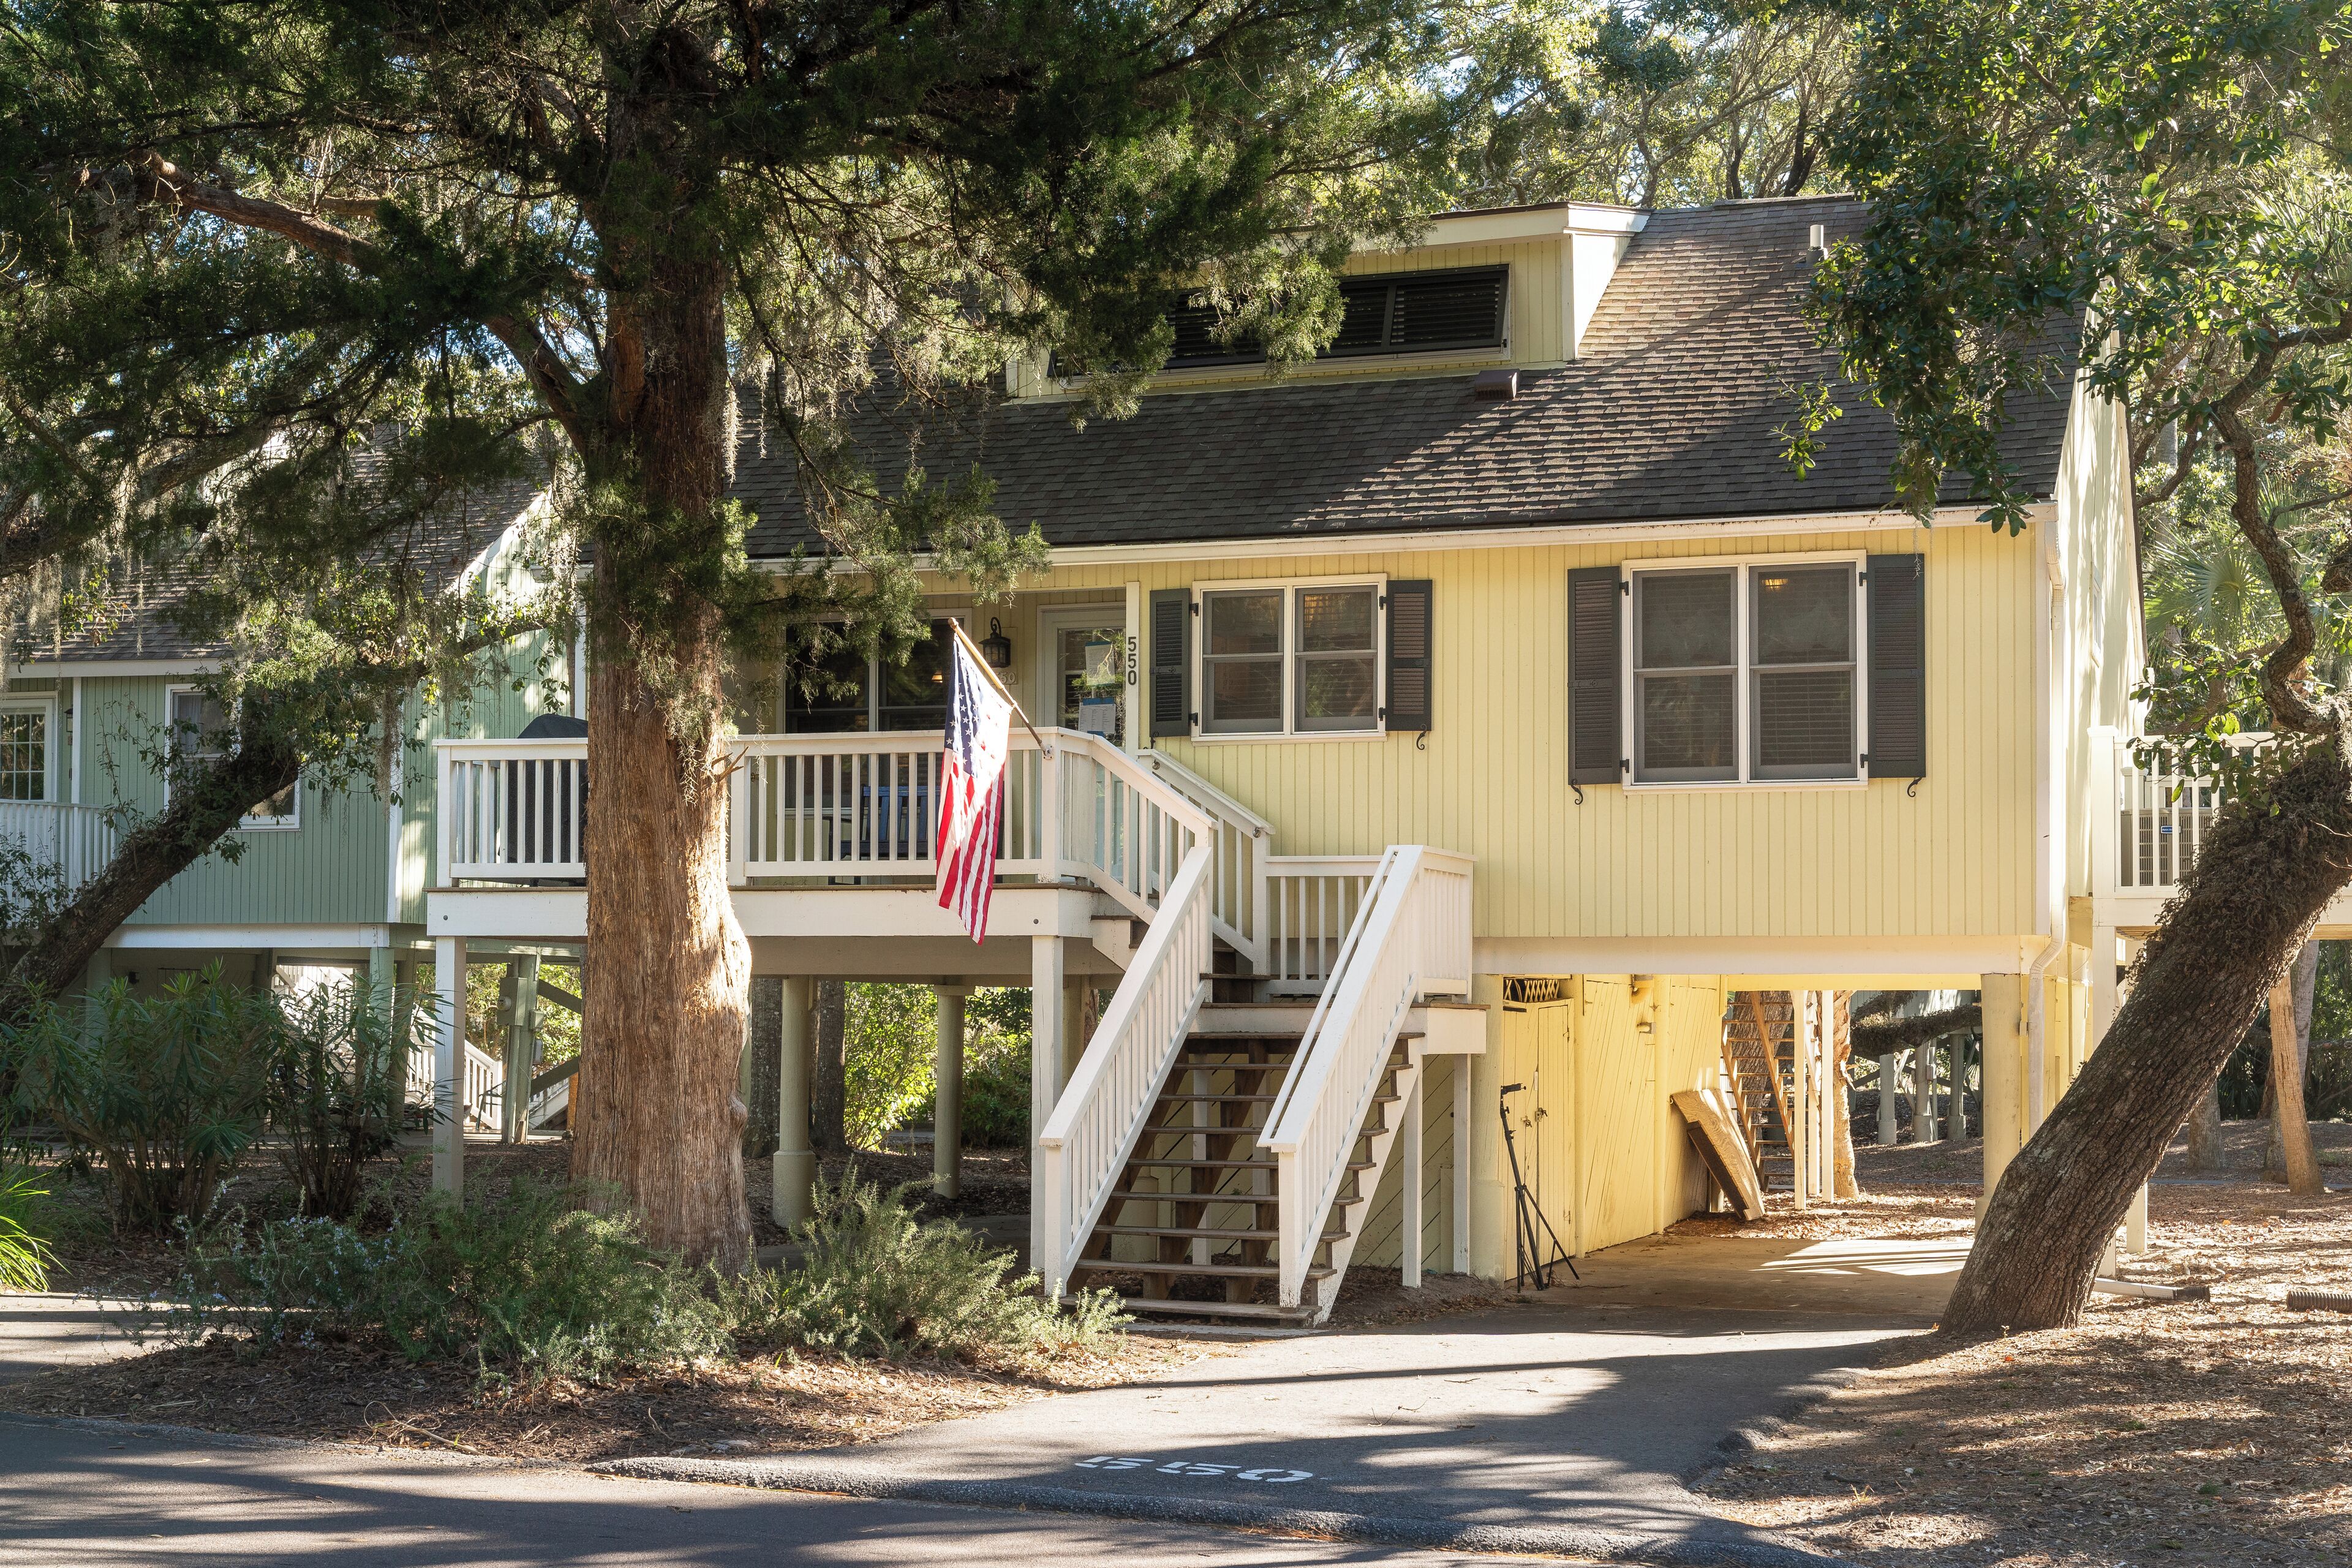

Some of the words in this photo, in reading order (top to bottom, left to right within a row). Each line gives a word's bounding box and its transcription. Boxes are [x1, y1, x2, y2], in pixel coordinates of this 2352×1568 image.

[1128, 636, 1137, 685] 550
[996, 671, 1016, 684] 50
[1074, 1456, 1313, 1482] 550
